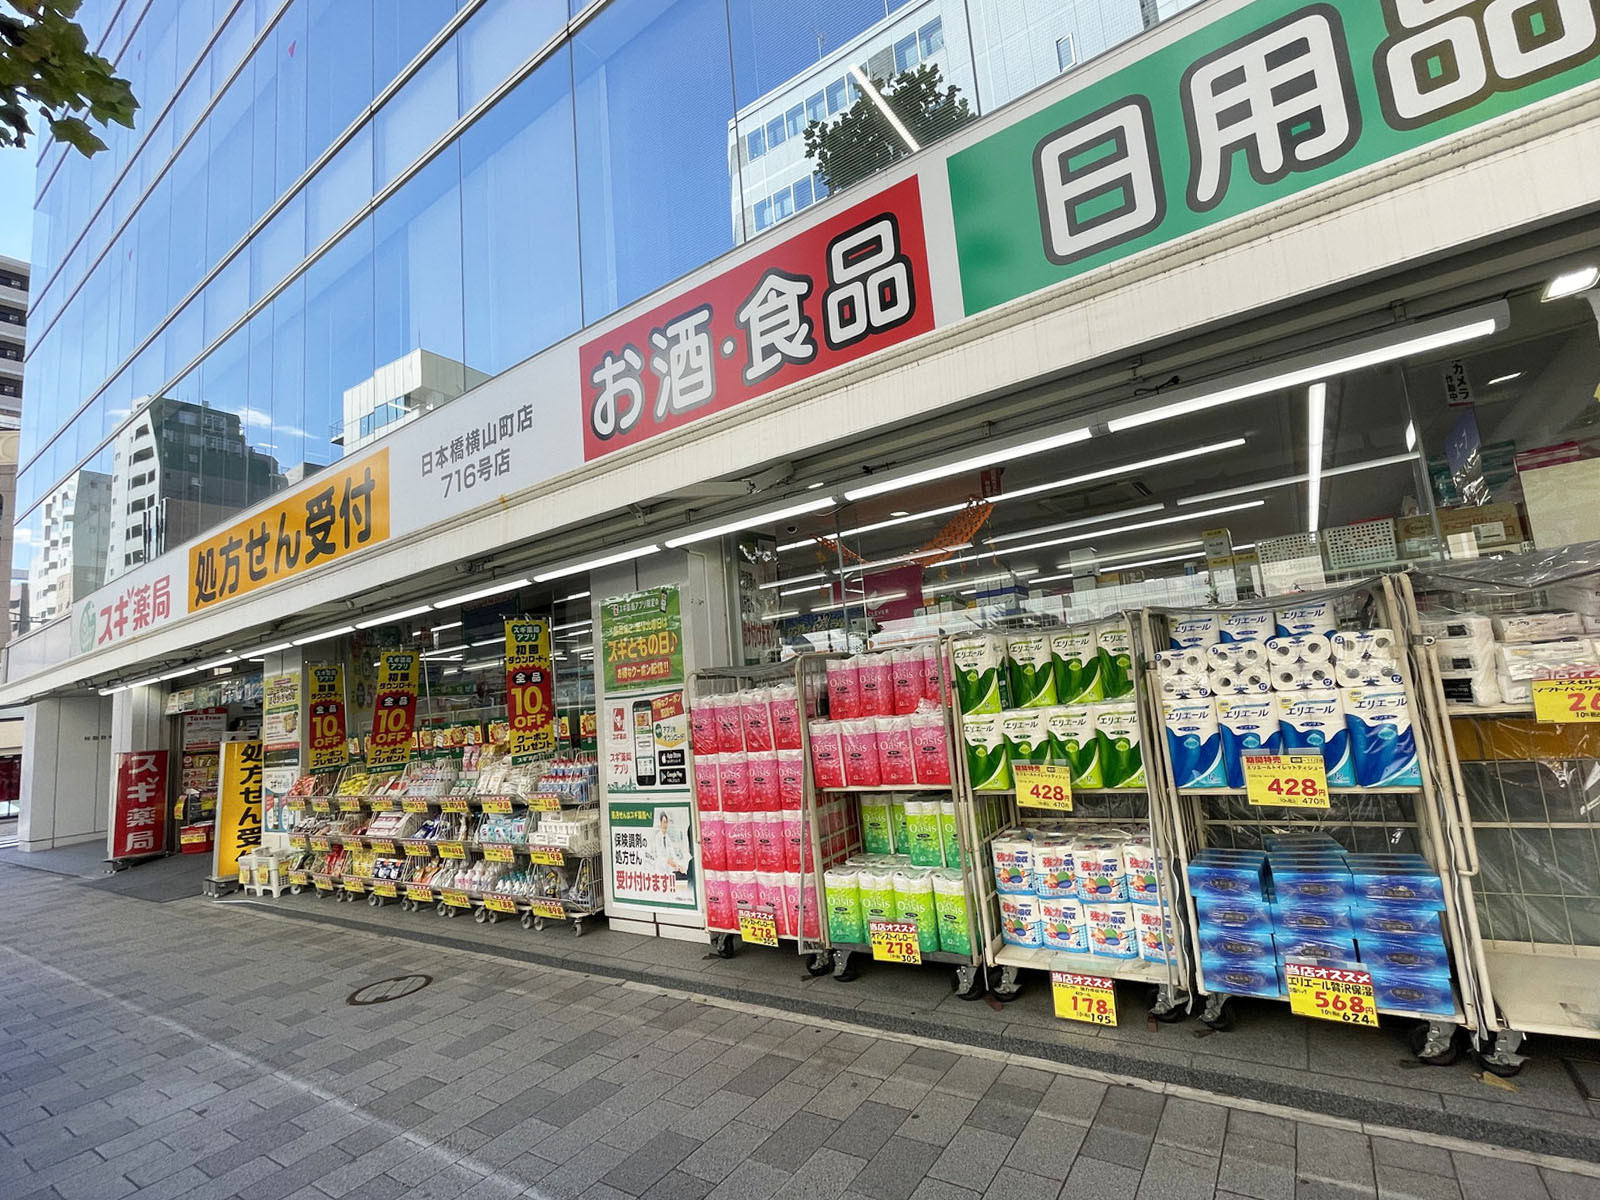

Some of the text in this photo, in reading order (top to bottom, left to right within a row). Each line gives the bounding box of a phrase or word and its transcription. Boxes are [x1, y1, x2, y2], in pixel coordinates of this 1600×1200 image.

[1035, 0, 1600, 262] 日用品
[591, 214, 914, 438] お酒・食品
[421, 403, 533, 478] 日本橋横山町店
[441, 448, 510, 499] 716号店
[195, 466, 376, 608] 処方せん受付
[98, 575, 171, 644] スギ薬局
[868, 609, 889, 617] CLEVER
[1281, 609, 1325, 620] エリエール
[1225, 616, 1267, 626] エリエール
[1174, 623, 1211, 634] エリエール
[1055, 639, 1089, 648] エリエール
[1103, 635, 1127, 643] エリエー
[516, 644, 539, 655] 初回
[955, 650, 985, 659] エリエール
[1011, 645, 1042, 653] エリエール
[515, 672, 542, 684] 全品
[830, 678, 854, 687] Oasis
[1355, 699, 1408, 710] エリエール
[1167, 711, 1209, 721] エリエール
[1223, 709, 1269, 720] エリエール
[1286, 706, 1335, 716] エリエール
[514, 714, 546, 728] OFF
[1006, 721, 1039, 730] エリエール
[1052, 719, 1086, 727] エリエール
[1100, 716, 1137, 724] エリエール
[314, 736, 341, 748] OFF
[376, 732, 407, 743] OFF
[517, 732, 549, 744] クーポン
[915, 736, 943, 746] Oasis
[514, 742, 553, 754] プレゼント
[812, 744, 837, 752] Oasis
[880, 740, 908, 750] Oasis
[316, 750, 342, 758] クーポン
[375, 747, 404, 757] クーポン
[312, 757, 346, 767] プレゼント
[371, 755, 407, 764] プレゼント
[614, 764, 629, 774] アプリ
[1030, 784, 1070, 802] 428円
[1267, 778, 1326, 797] 428円
[125, 754, 159, 852] スギ薬局
[863, 814, 886, 823] Oasis
[909, 823, 937, 833] Oasis
[615, 833, 647, 848] 保険調剤の
[615, 850, 642, 865] 処方せん
[1081, 861, 1118, 872] 強力吸収
[616, 871, 676, 893] 受け付けます!!
[731, 891, 754, 900] Oasis
[828, 896, 854, 907] Oasis
[863, 898, 890, 909] Oasis
[897, 901, 925, 913] Oasis
[937, 902, 964, 915] Oasis
[1043, 906, 1076, 920] 強力吸収
[1090, 911, 1126, 925] 強力吸収
[886, 942, 919, 955] 278円
[1286, 964, 1370, 984] 当店オススメ
[1052, 972, 1112, 988] 当店オススメ
[1288, 976, 1373, 996] エリエール贅沢保湿
[1072, 996, 1114, 1017] 178円
[1315, 991, 1374, 1015] 568円
